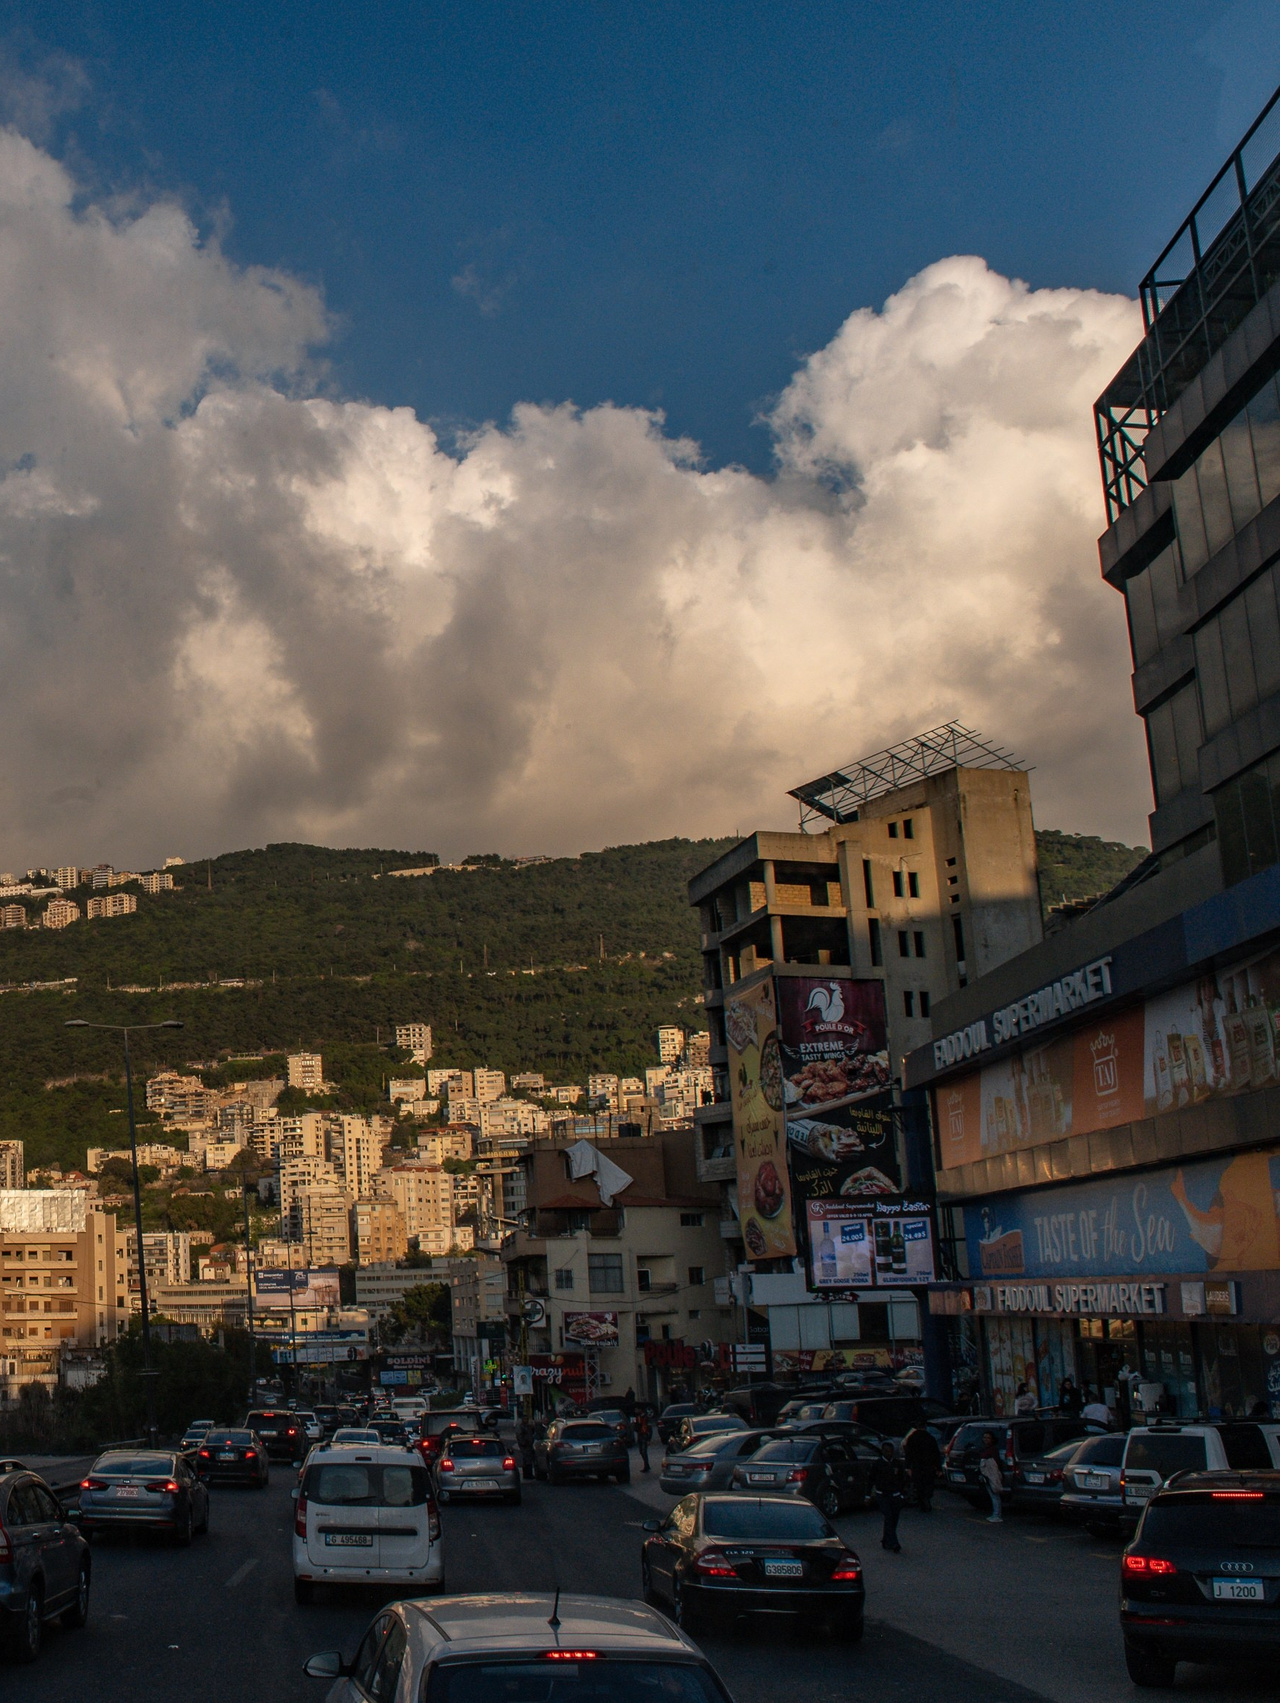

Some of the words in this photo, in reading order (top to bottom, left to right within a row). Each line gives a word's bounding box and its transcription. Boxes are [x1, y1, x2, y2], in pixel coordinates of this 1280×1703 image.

[933, 1020, 992, 1071] FADDOUL
[993, 956, 1113, 1045] SUPERMARKET
[815, 1022, 836, 1032] POULE
[837, 1022, 854, 1034] D'OR
[799, 1040, 844, 1053] EXTREME
[801, 1053, 821, 1061] TASTY
[823, 1051, 845, 1060] WINGS
[1096, 1061, 1114, 1087] TAJ
[856, 1120, 883, 1137] اللبنانية
[876, 1201, 901, 1214] Happy
[902, 1200, 930, 1211] Easter
[1035, 1213, 1079, 1263] TASTE
[1079, 1210, 1098, 1259] OF
[1101, 1196, 1126, 1262] the
[1131, 1184, 1176, 1263] Sea
[996, 1286, 1052, 1312] FADDOUL
[1055, 1283, 1167, 1314] SUPERMARKET
[1205, 1291, 1230, 1304] LAUDERS
[644, 1339, 695, 1368] Poule
[331, 1535, 337, 1544] G
[340, 1535, 367, 1544] 495468
[766, 1564, 802, 1575] G385806
[1216, 1586, 1222, 1597] J
[1230, 1586, 1257, 1598] 1200
